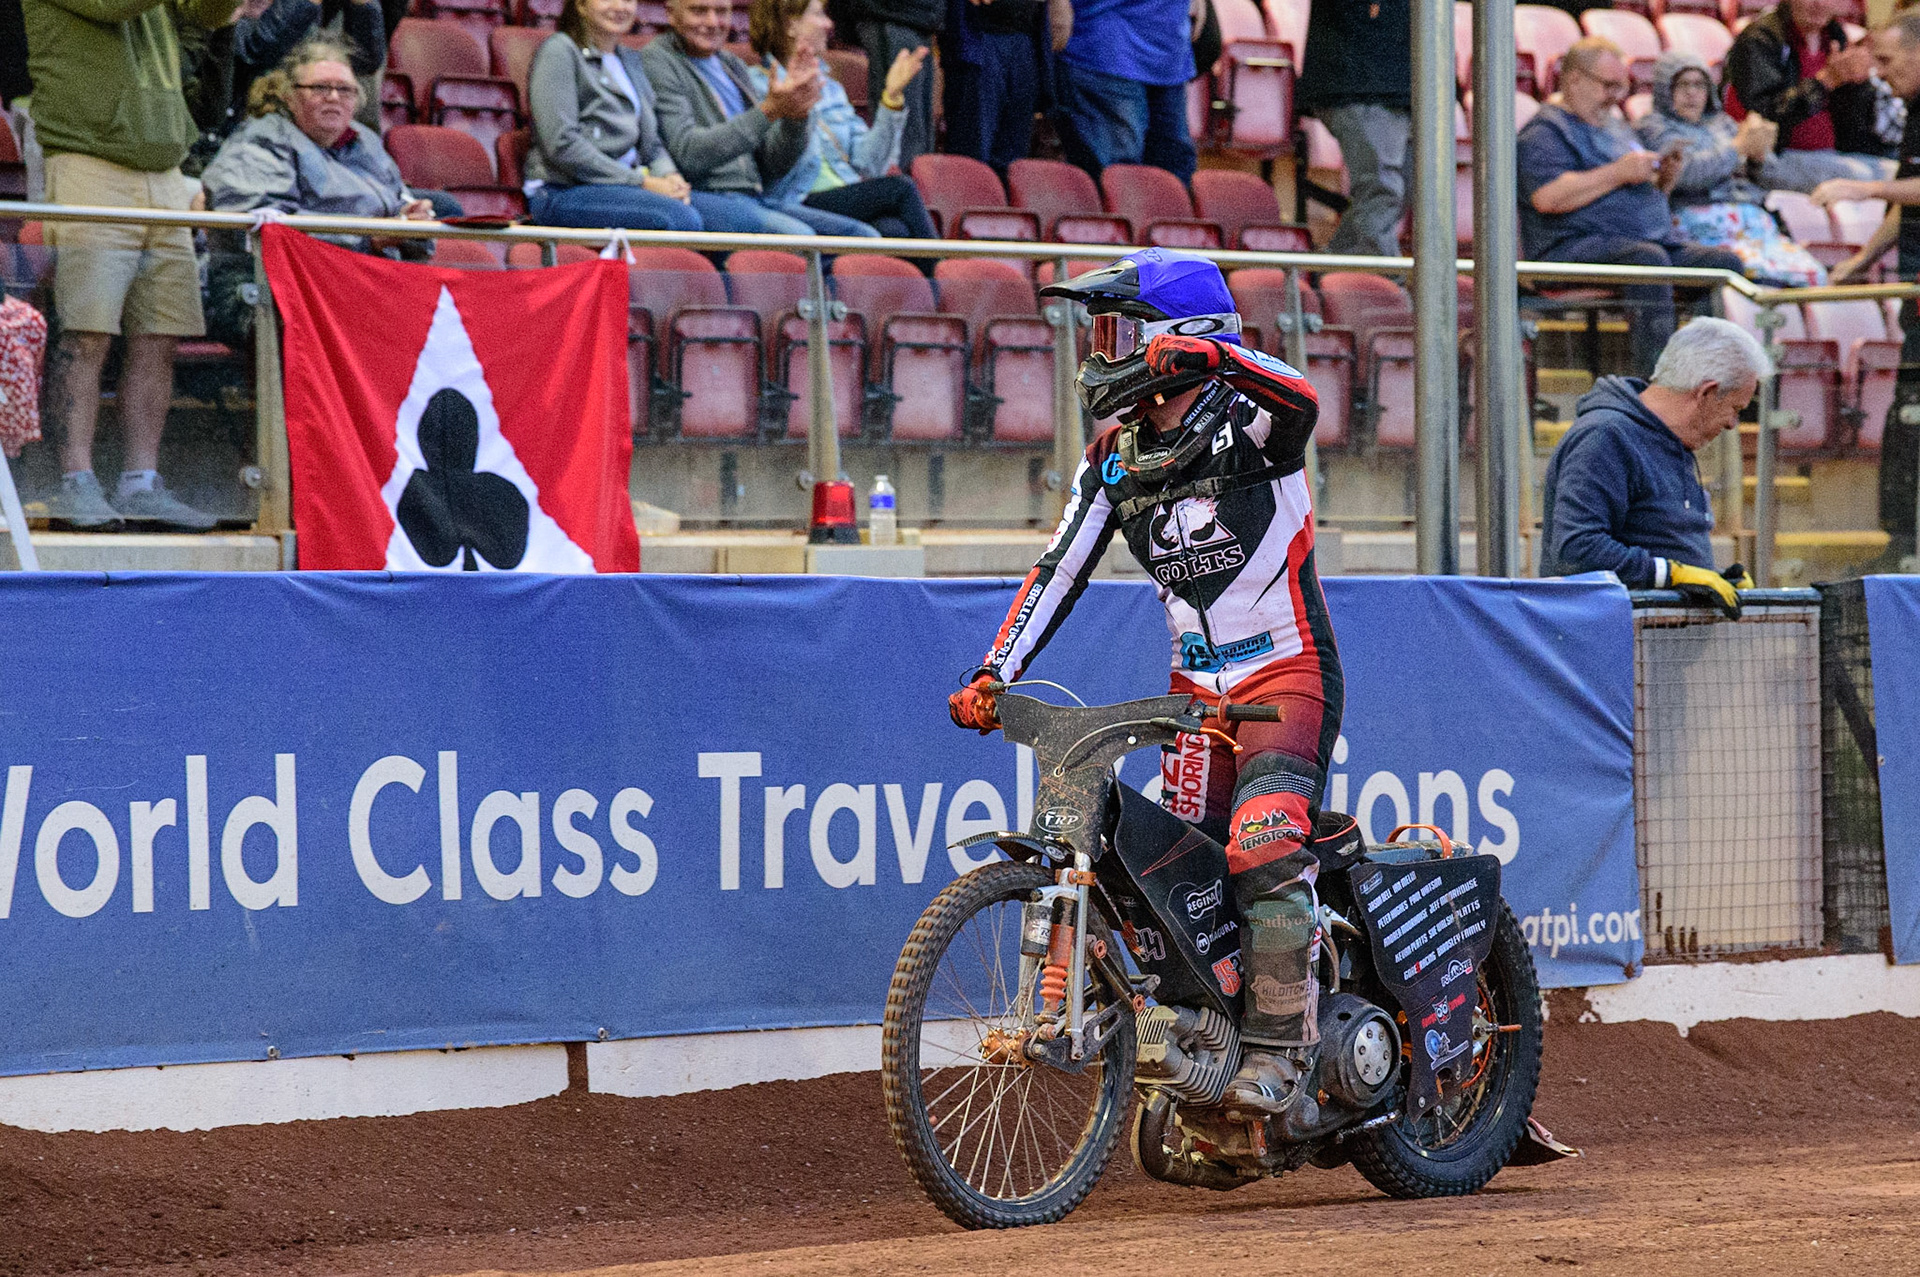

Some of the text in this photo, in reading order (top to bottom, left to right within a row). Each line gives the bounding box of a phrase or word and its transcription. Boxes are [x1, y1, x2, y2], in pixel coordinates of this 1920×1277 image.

[1180, 733, 1205, 818] SHORING
[348, 751, 659, 905] Class
[698, 742, 1034, 890] Travel
[1045, 811, 1079, 827] FRP
[1240, 828, 1307, 852] TENGTOO
[1187, 893, 1217, 913] REGINA
[1460, 919, 1487, 940] FAMILY
